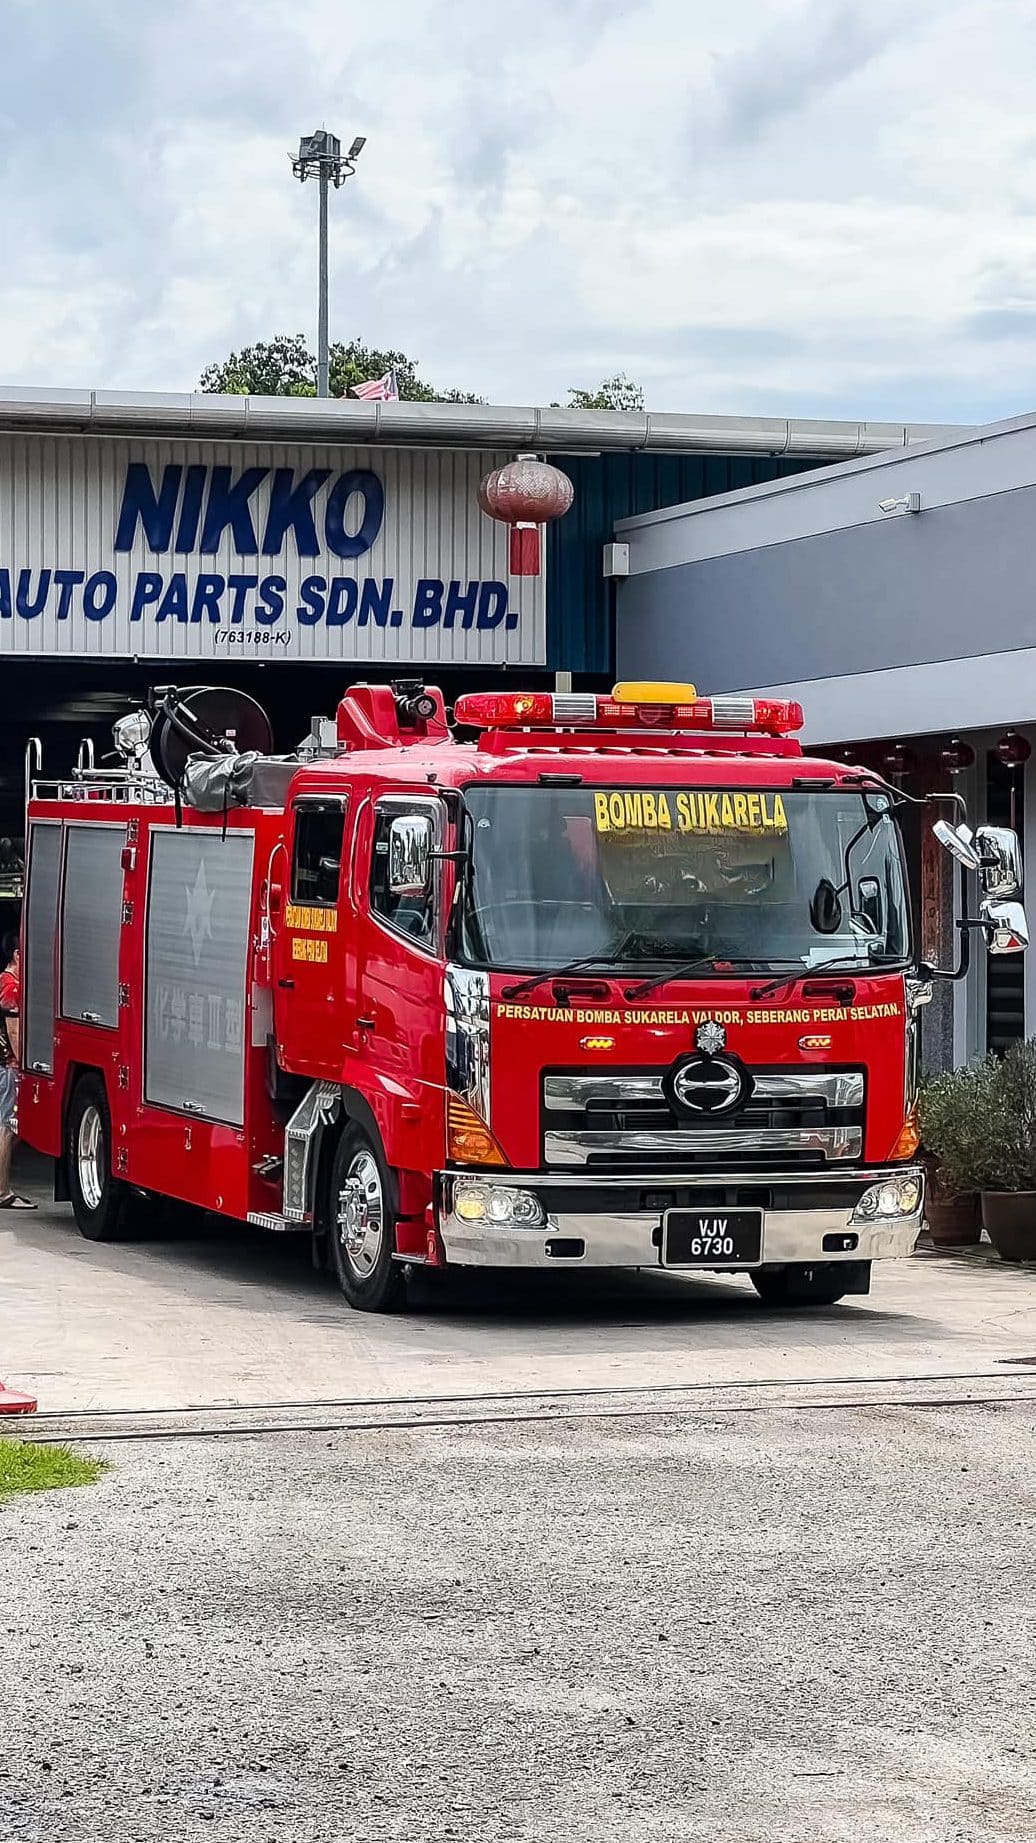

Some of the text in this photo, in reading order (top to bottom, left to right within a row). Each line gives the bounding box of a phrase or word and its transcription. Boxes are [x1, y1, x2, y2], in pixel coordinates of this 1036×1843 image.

[114, 463, 385, 559] NIKKO
[130, 572, 287, 625] PARTS
[297, 576, 403, 627] SDN.
[412, 579, 518, 630] BHD.
[214, 629, 291, 645] (763188-K)
[594, 793, 788, 832] BOMBA SUKARELA
[497, 1005, 574, 1023] PERSATUAN
[576, 1011, 621, 1024] BOMBA
[624, 1011, 690, 1024] SUKARELA
[747, 1008, 809, 1024] SEBERANG
[813, 1007, 847, 1021] PERAI
[850, 1003, 901, 1020] SELATAN.
[699, 1219, 728, 1236] VJV
[691, 1237, 734, 1255] 6730
